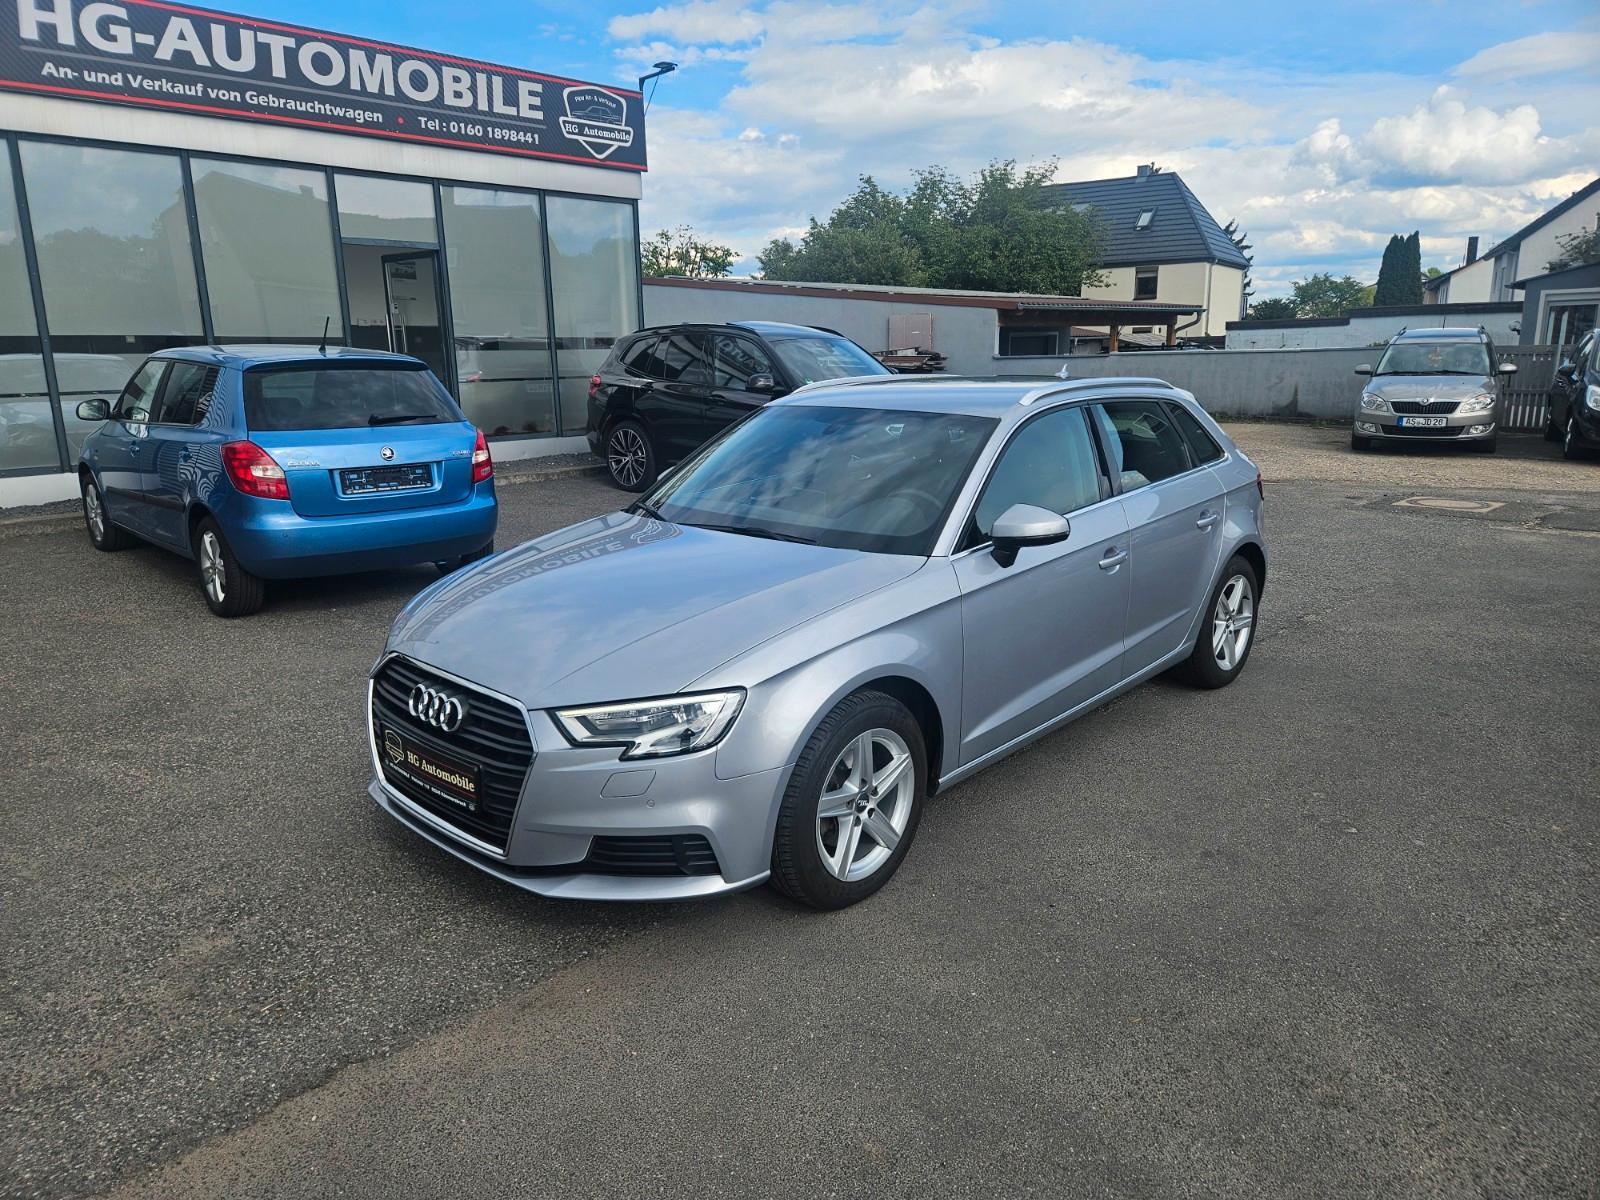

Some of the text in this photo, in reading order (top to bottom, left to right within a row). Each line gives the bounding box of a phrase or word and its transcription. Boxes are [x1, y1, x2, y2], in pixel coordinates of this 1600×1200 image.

[17, 0, 543, 120] HG-AUTOMOBILE
[41, 62, 79, 80] An-
[83, 69, 123, 87] und
[127, 73, 204, 97] Verkauf
[207, 87, 241, 103] von
[245, 90, 383, 124] Gebrauchtwagen
[449, 121, 483, 137] 0160
[487, 126, 539, 145] 1898441
[565, 123, 631, 141] HG Automobile
[406, 750, 420, 767] HG
[421, 759, 476, 793] Automobile
